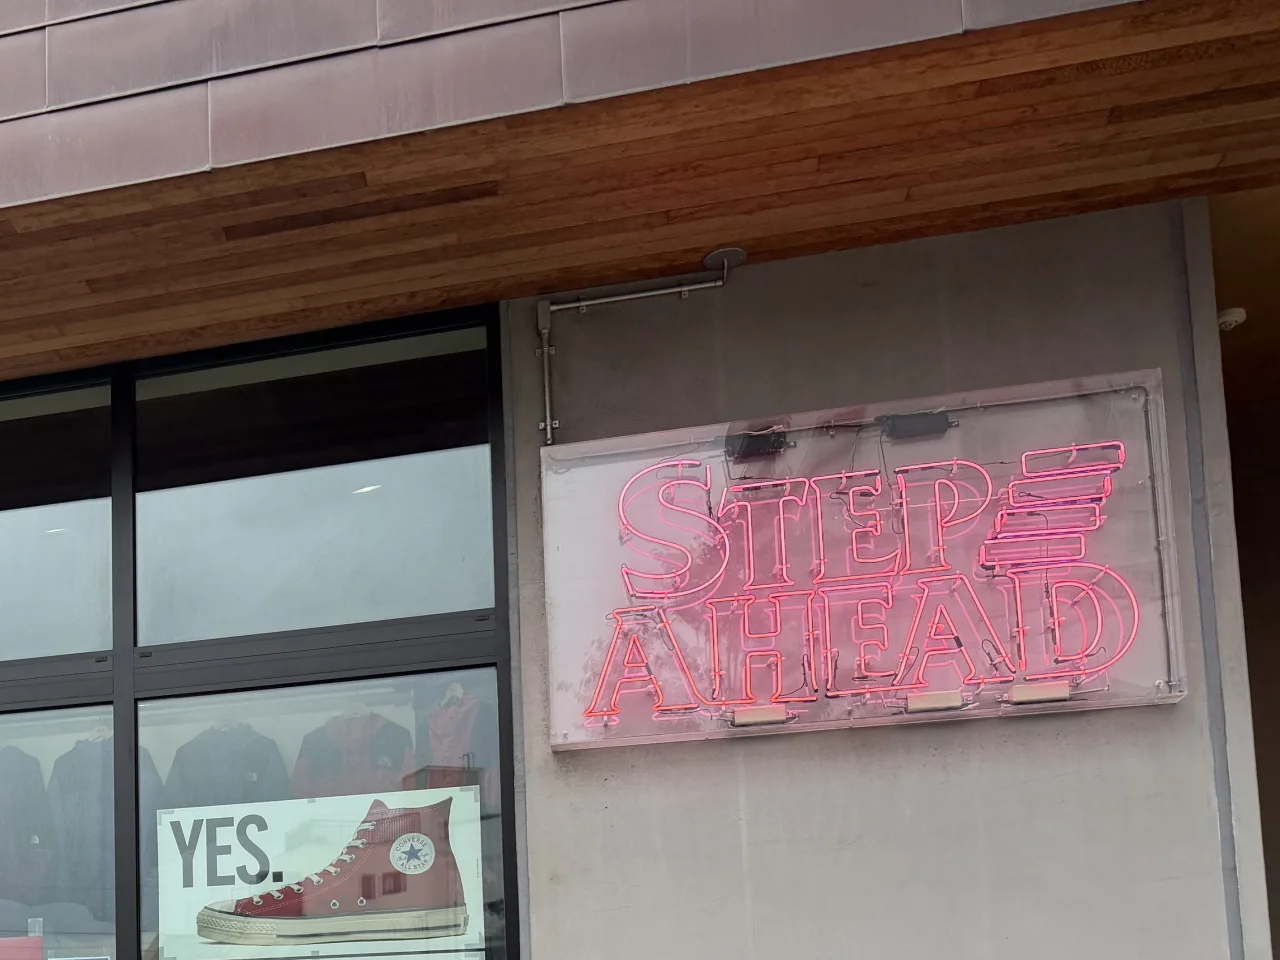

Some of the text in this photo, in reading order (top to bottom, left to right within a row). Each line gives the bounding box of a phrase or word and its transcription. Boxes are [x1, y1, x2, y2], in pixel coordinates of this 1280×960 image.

[618, 458, 993, 598] STEP
[584, 561, 1139, 716] AHEAD
[170, 814, 283, 888] YES.
[395, 837, 428, 851] CONVERSE
